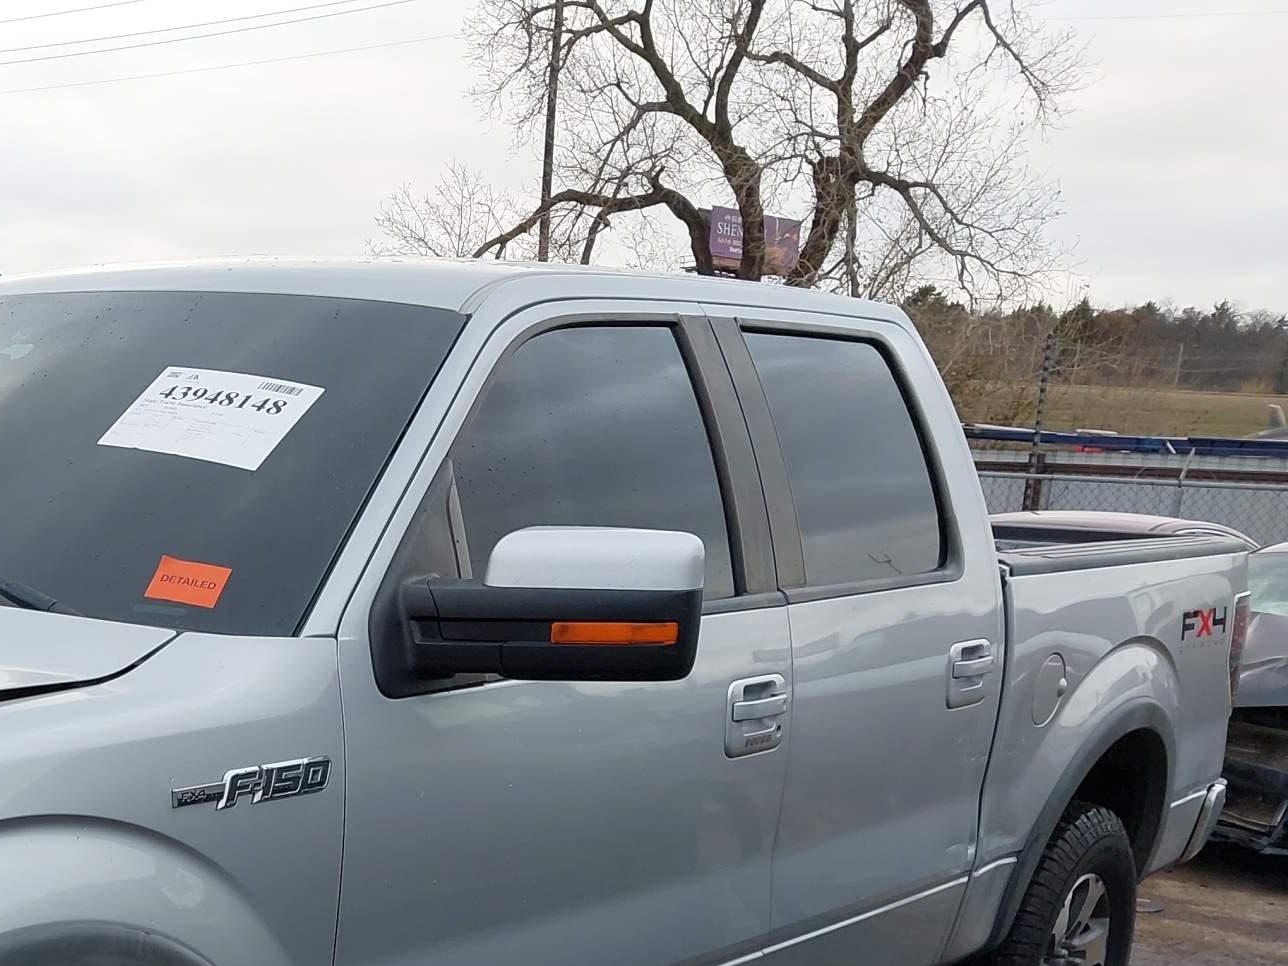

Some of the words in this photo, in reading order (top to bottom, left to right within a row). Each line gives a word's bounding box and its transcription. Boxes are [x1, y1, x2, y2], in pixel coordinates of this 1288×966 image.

[159, 385, 288, 415] 43948148
[159, 574, 216, 591] DETAILED
[1180, 605, 1227, 640] FX4
